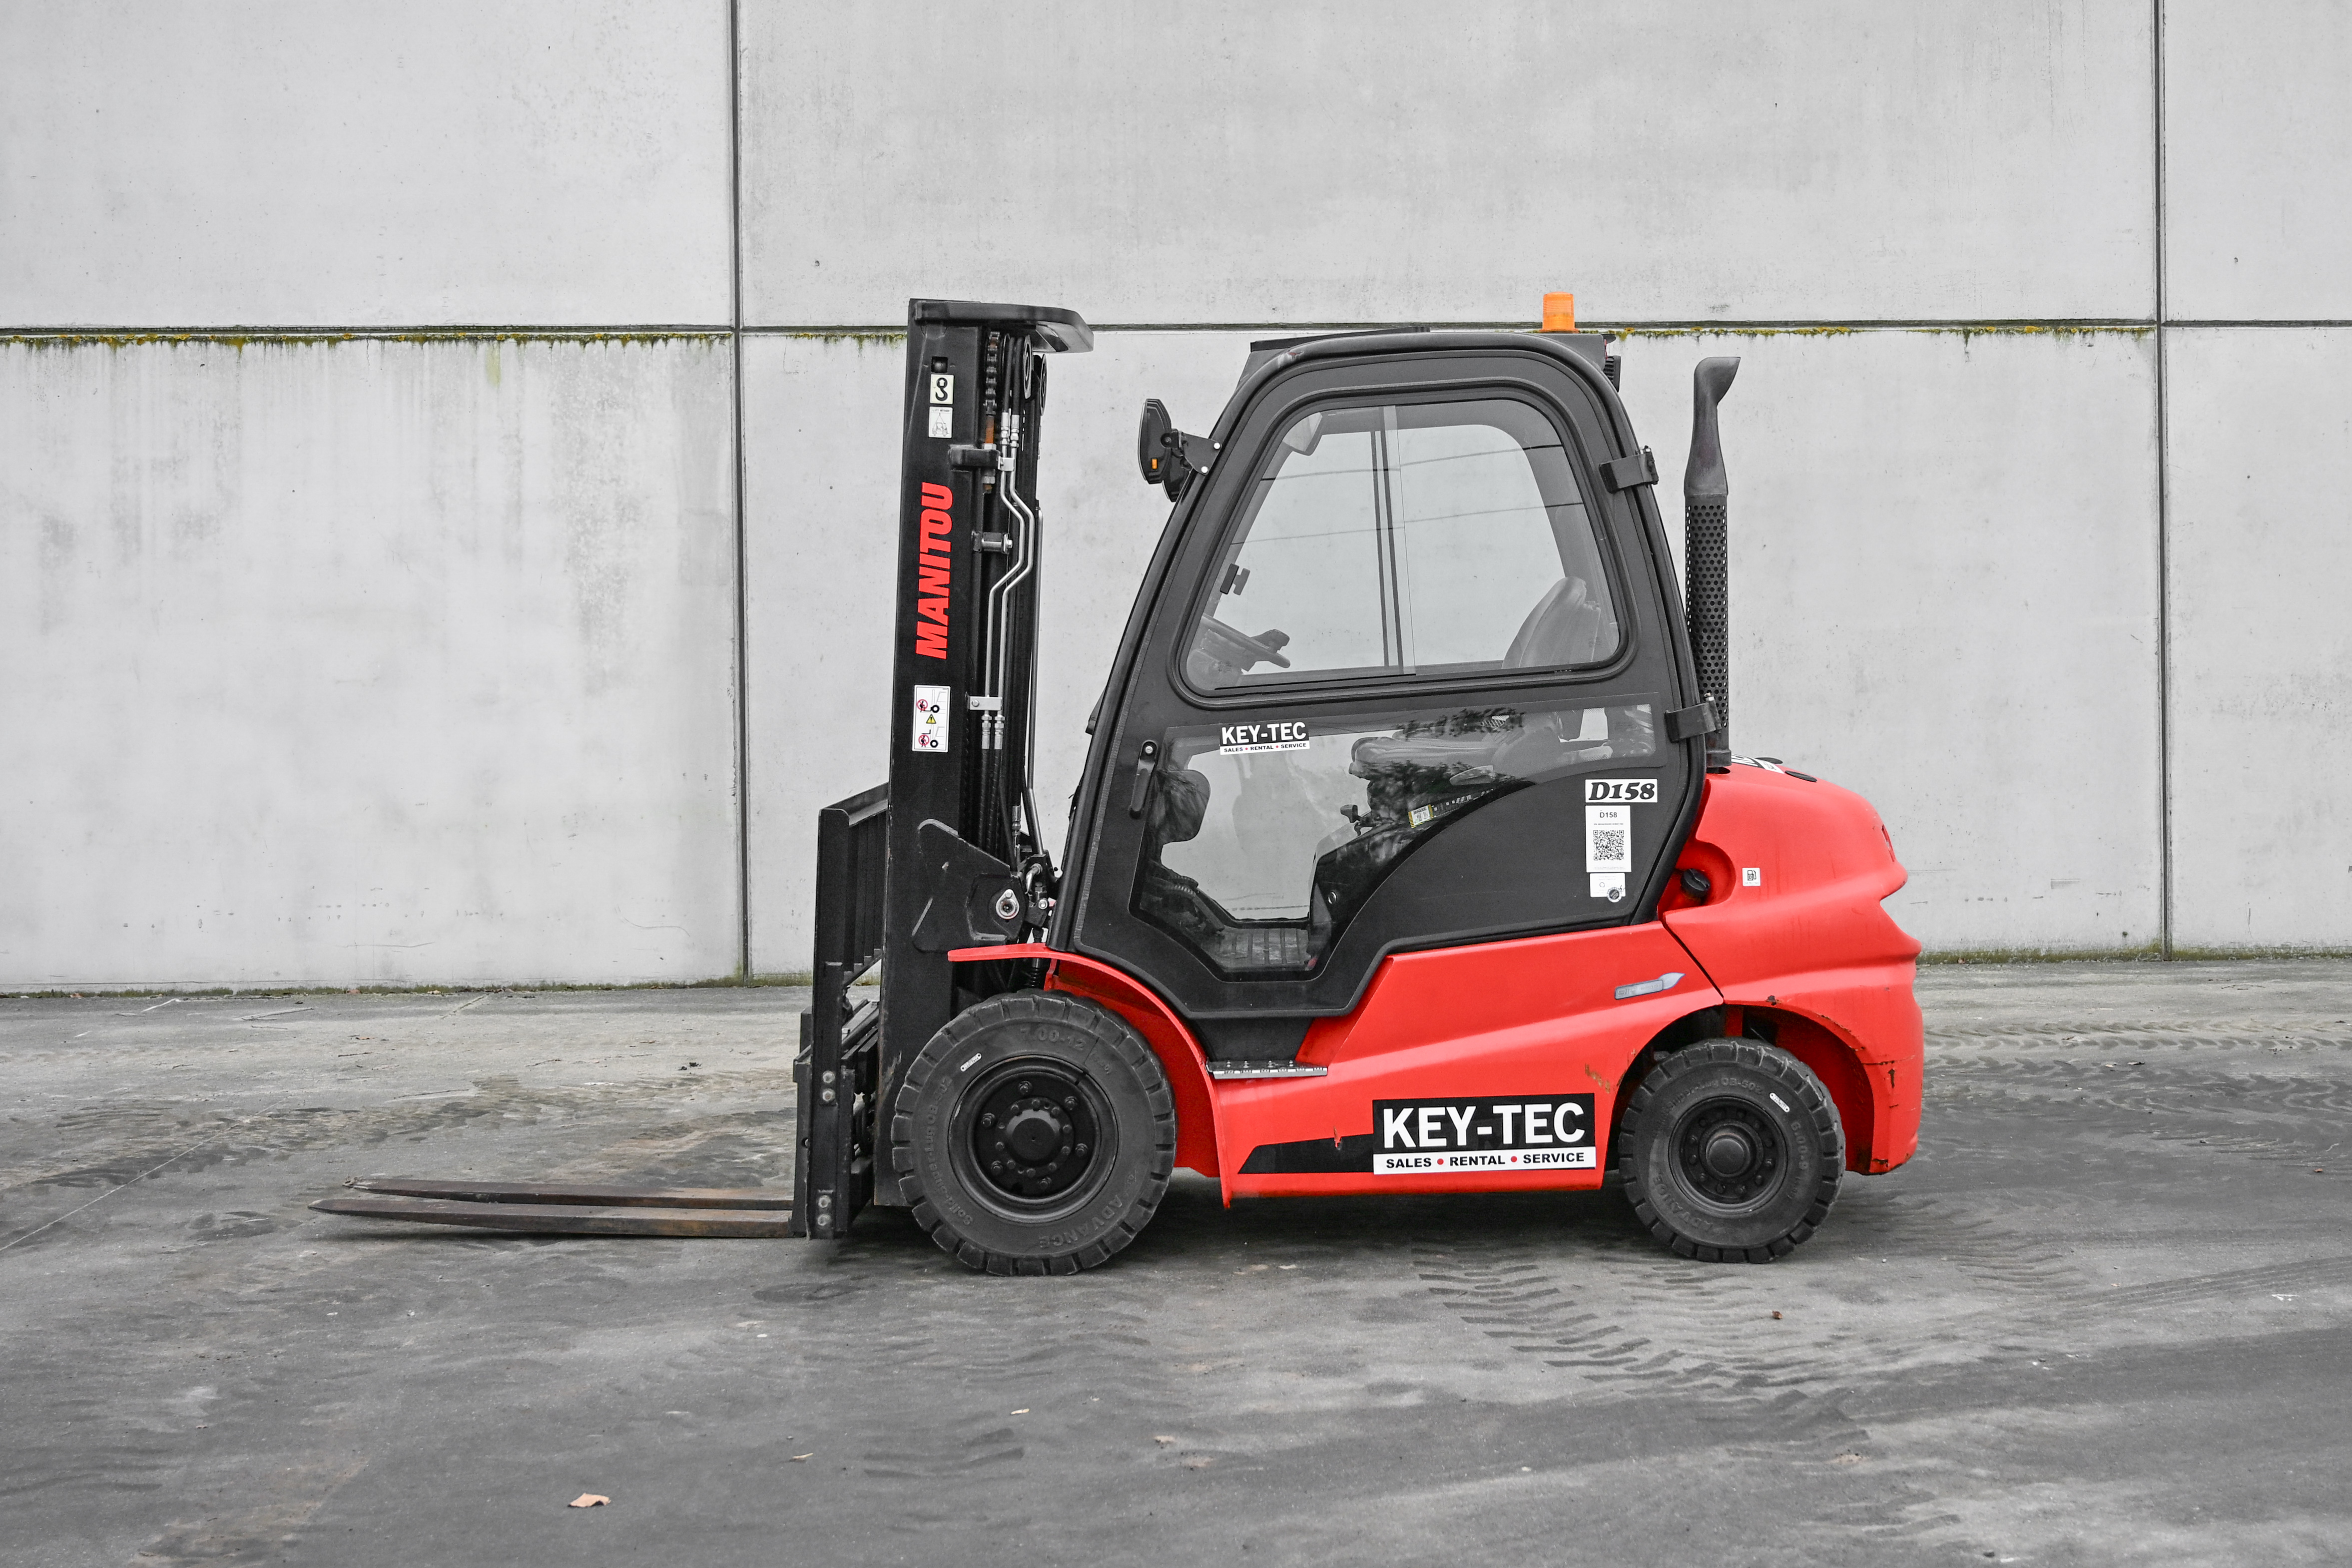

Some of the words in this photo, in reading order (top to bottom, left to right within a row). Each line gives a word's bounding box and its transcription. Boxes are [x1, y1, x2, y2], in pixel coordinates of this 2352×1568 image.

[916, 482, 953, 659] MANITOU
[1221, 722, 1307, 744] KEY-TEC
[1588, 782, 1655, 800] D158
[1383, 1102, 1585, 1148] KEY-TEC
[1386, 1157, 1432, 1168] SALES
[1450, 1155, 1505, 1166] RENTAL
[1523, 1152, 1584, 1164] SERVICE
[1039, 1194, 1123, 1248] ADVANCE
